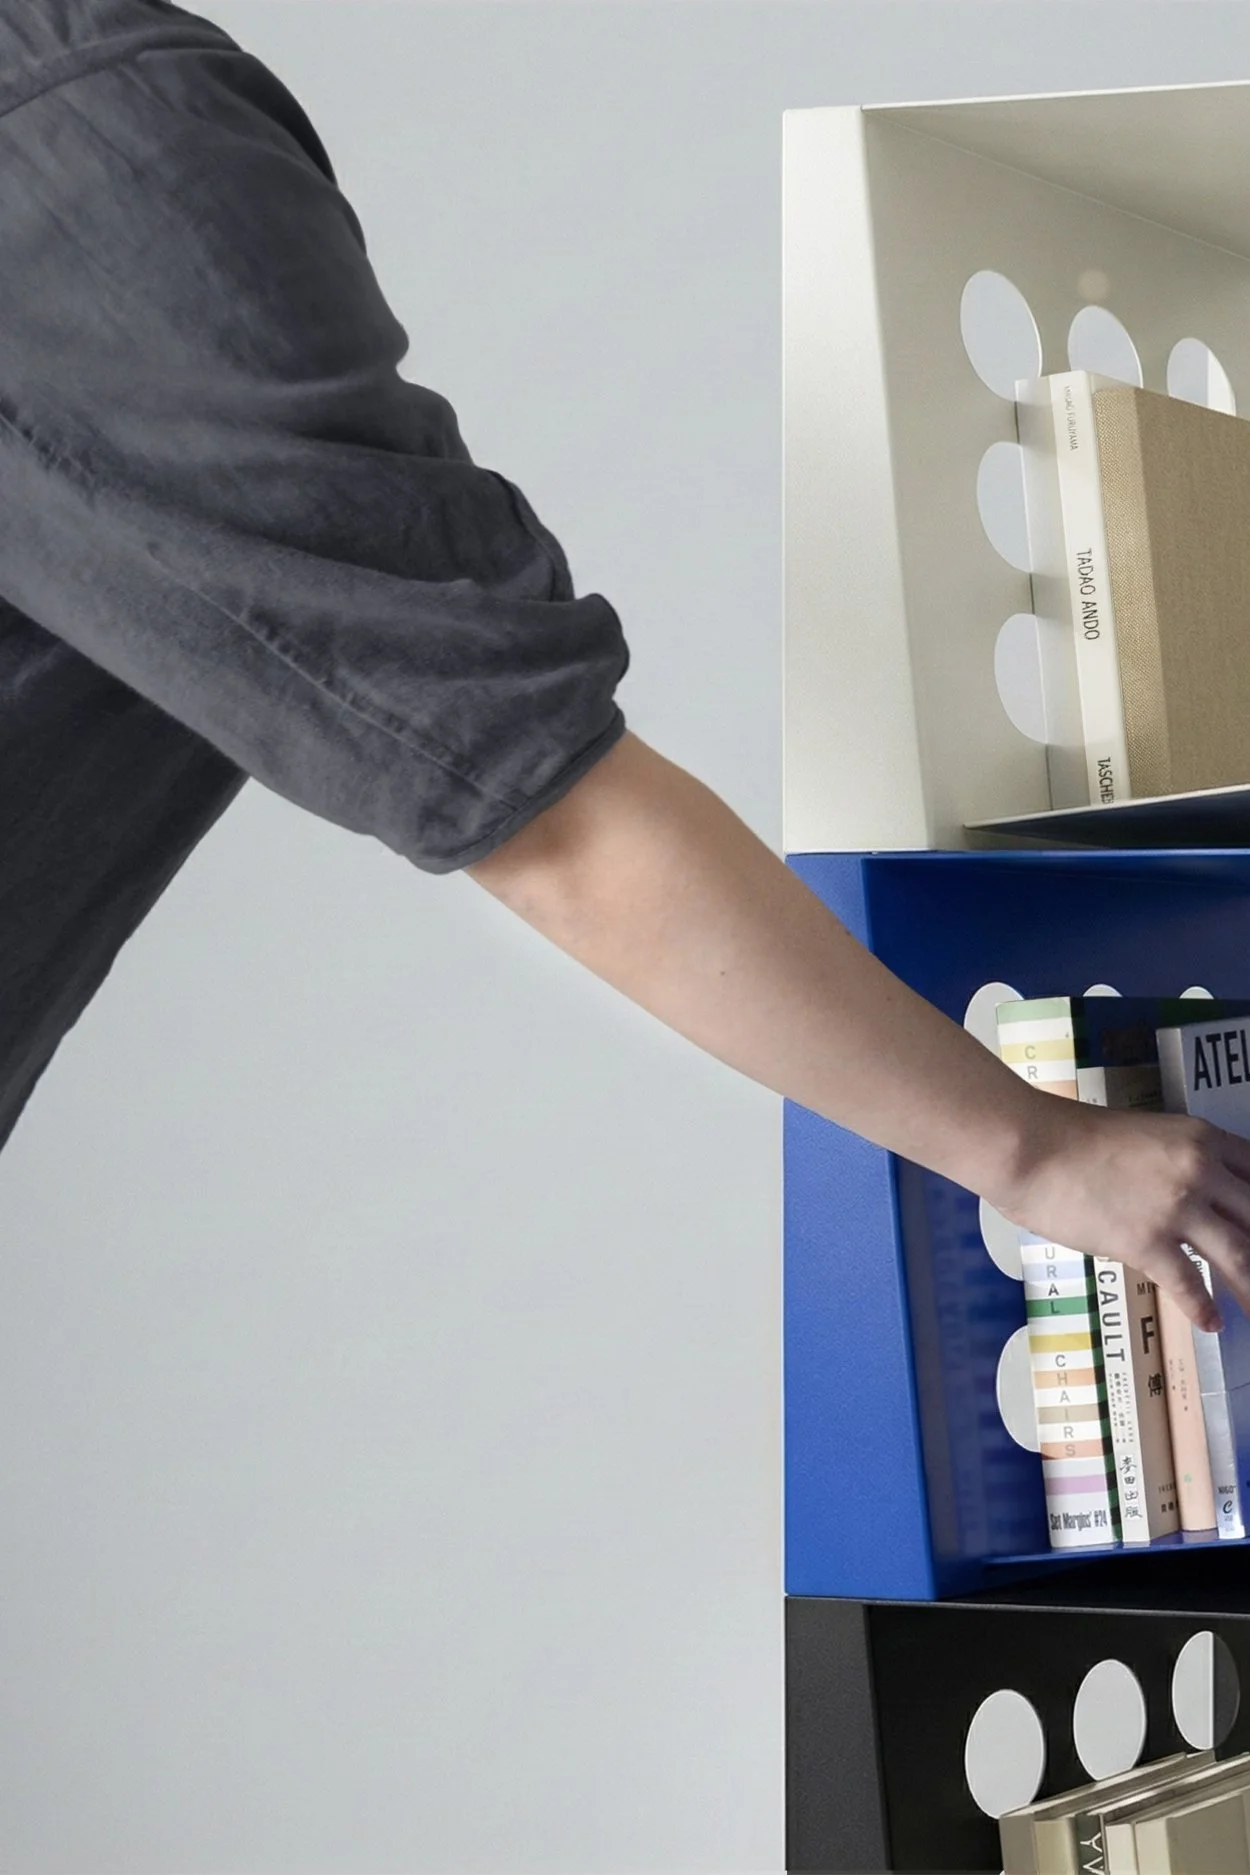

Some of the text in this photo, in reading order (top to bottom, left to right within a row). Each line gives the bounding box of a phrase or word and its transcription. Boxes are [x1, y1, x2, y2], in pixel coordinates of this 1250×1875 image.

[1076, 548, 1100, 640] TADAO ANDO
[1097, 757, 1114, 804] TASCHE
[1097, 1258, 1125, 1362] CAULT
[1055, 1354, 1075, 1458] CHAIRS
